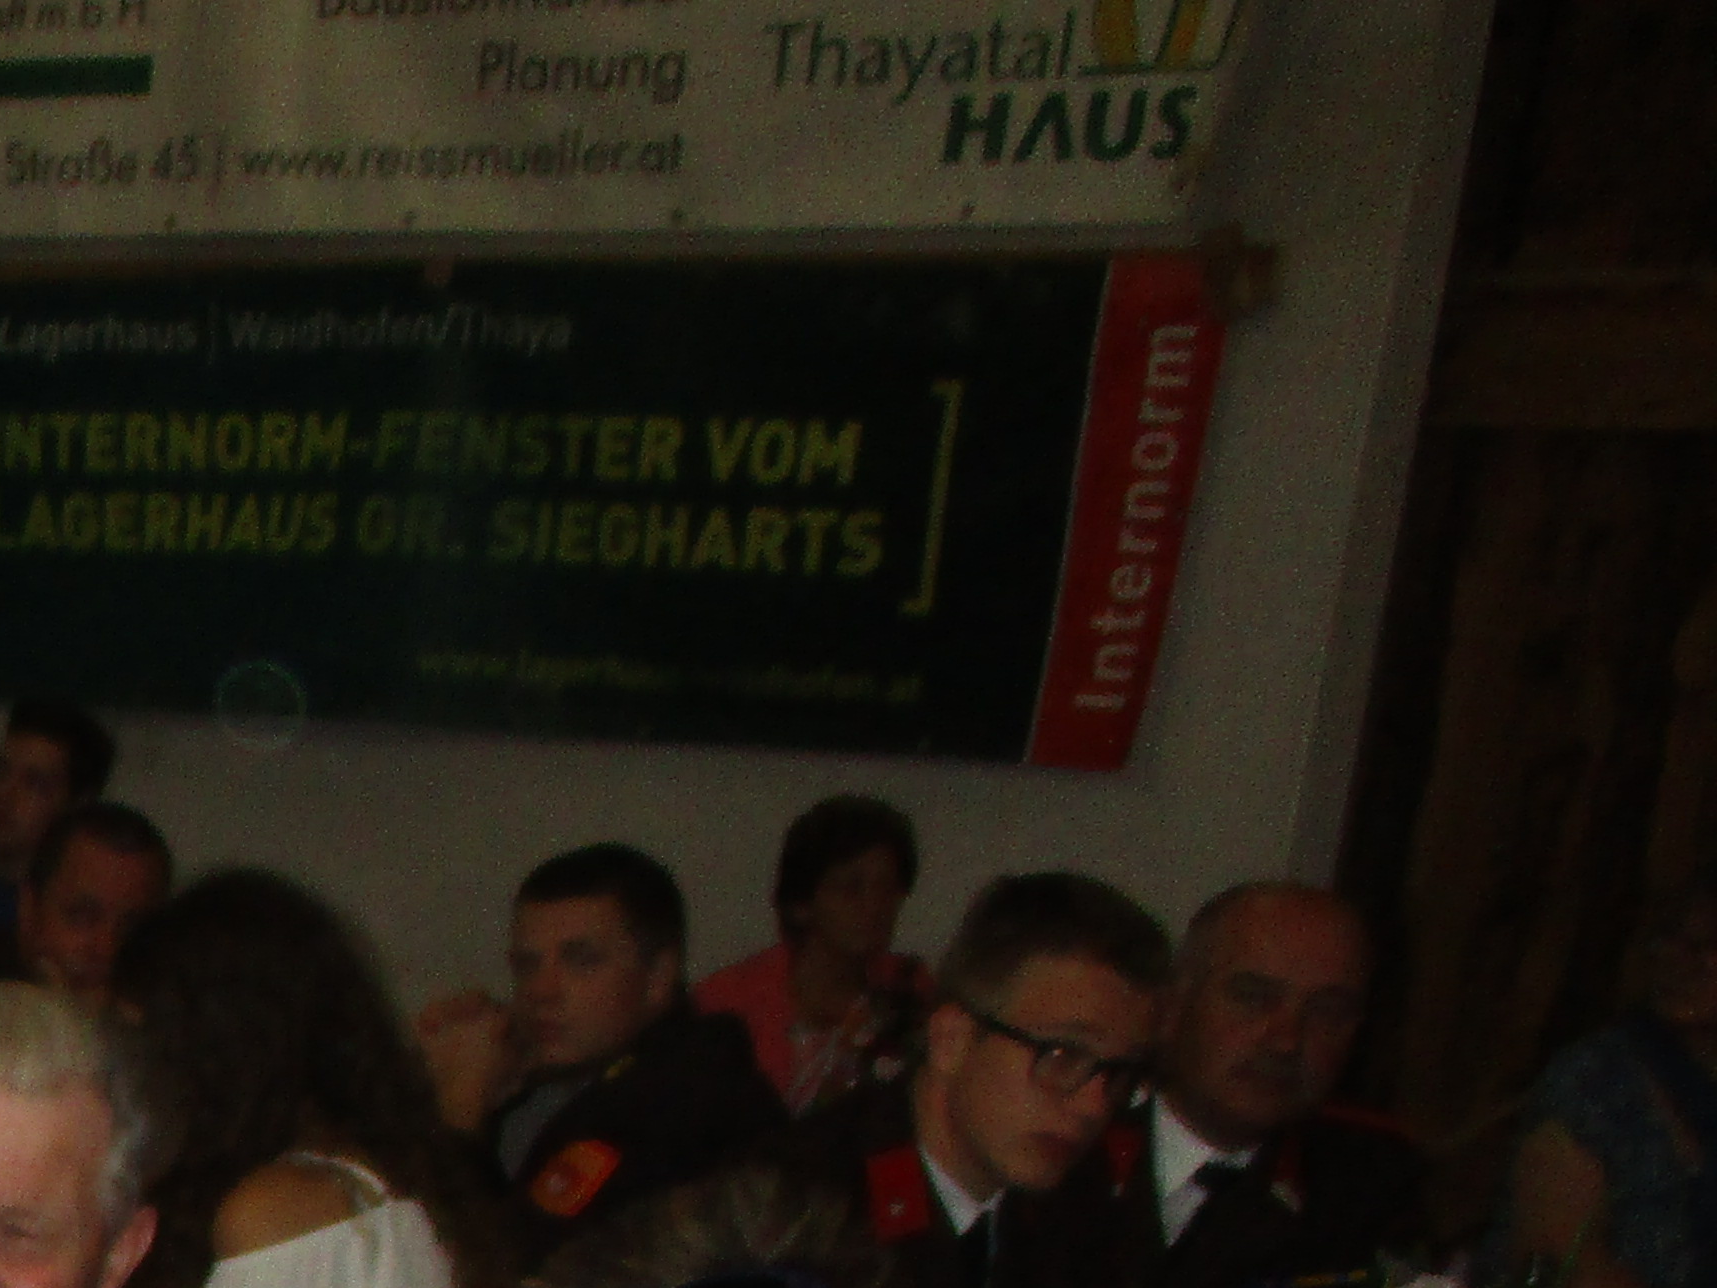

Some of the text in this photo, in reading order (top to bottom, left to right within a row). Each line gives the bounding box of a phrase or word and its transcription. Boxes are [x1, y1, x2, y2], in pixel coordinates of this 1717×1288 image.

[477, 38, 687, 104] Planung
[764, 12, 1073, 104] Thayatal
[4, 137, 138, 189] Straße
[941, 87, 1196, 165] HAUS
[708, 417, 863, 486] VOM
[356, 494, 464, 559] GR.
[487, 502, 883, 576] SIEGHARTS
[1074, 323, 1198, 713] Internorm
